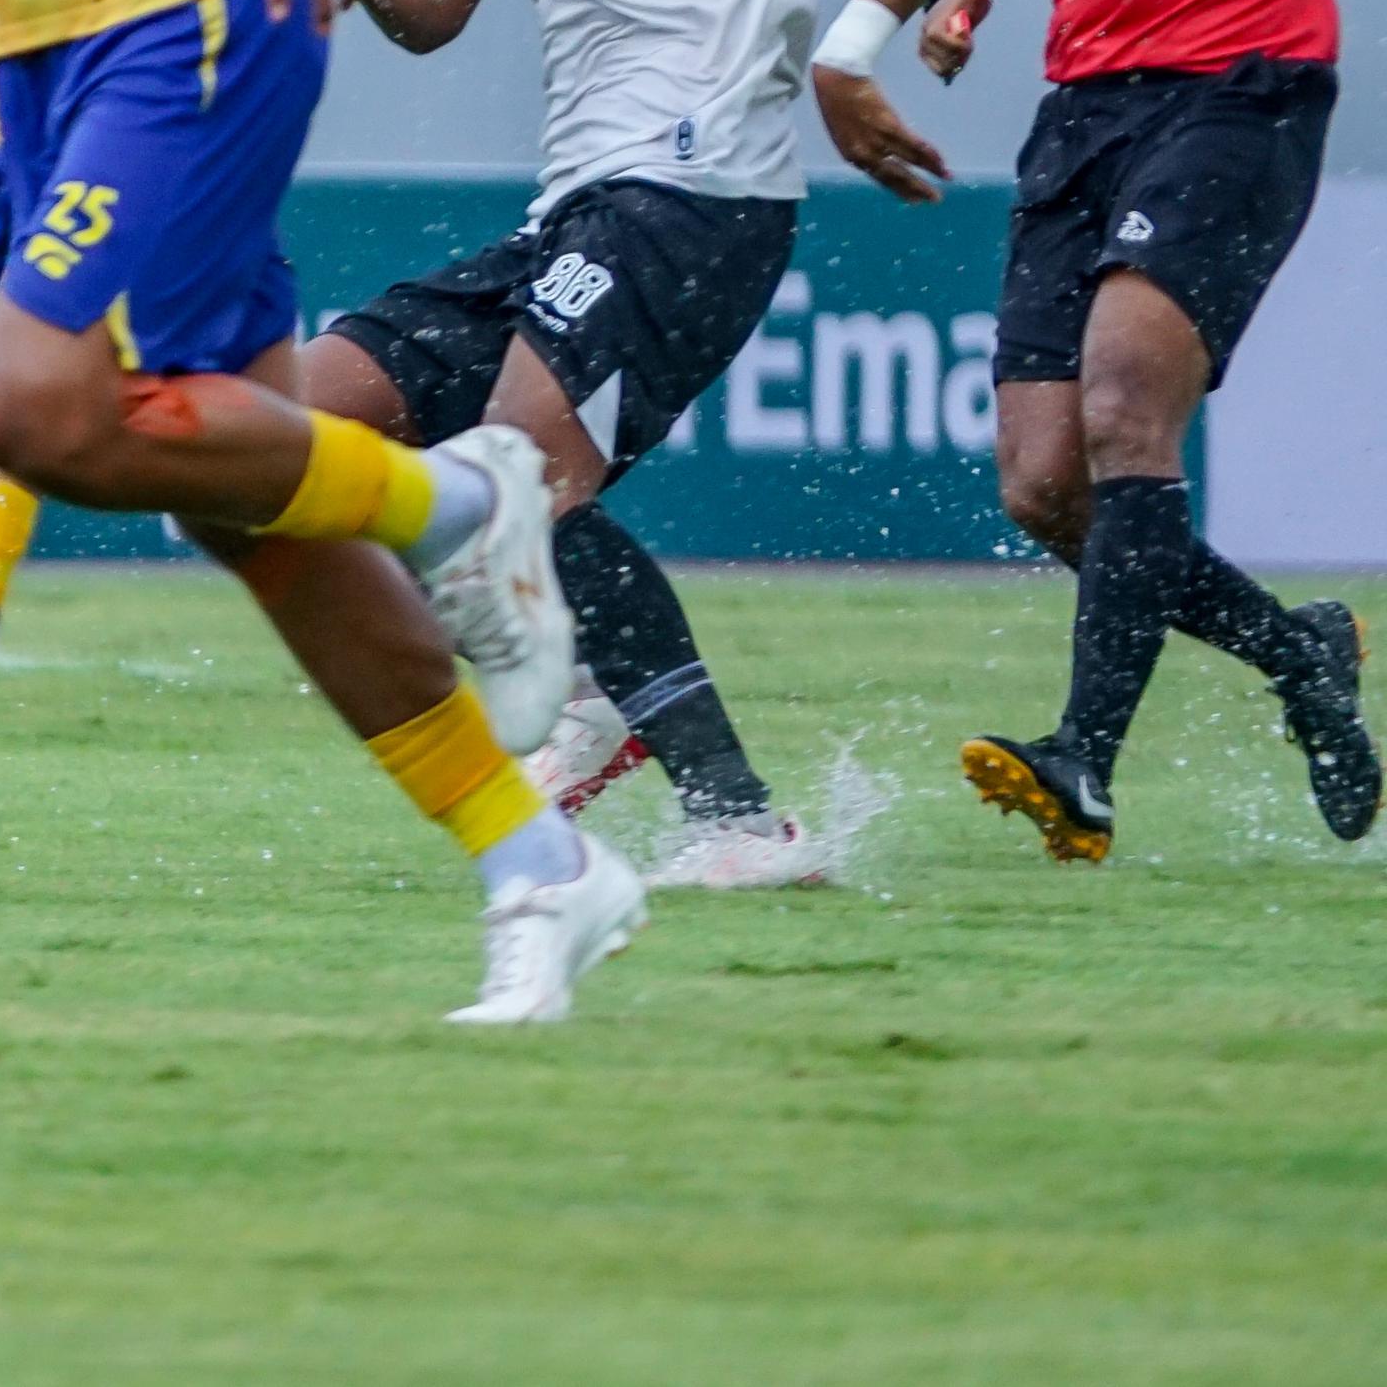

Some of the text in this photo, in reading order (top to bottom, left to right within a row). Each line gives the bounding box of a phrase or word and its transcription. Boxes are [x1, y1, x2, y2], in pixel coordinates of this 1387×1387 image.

[42, 179, 120, 248] 25
[530, 251, 615, 318] 88
[729, 269, 999, 452] Ema
